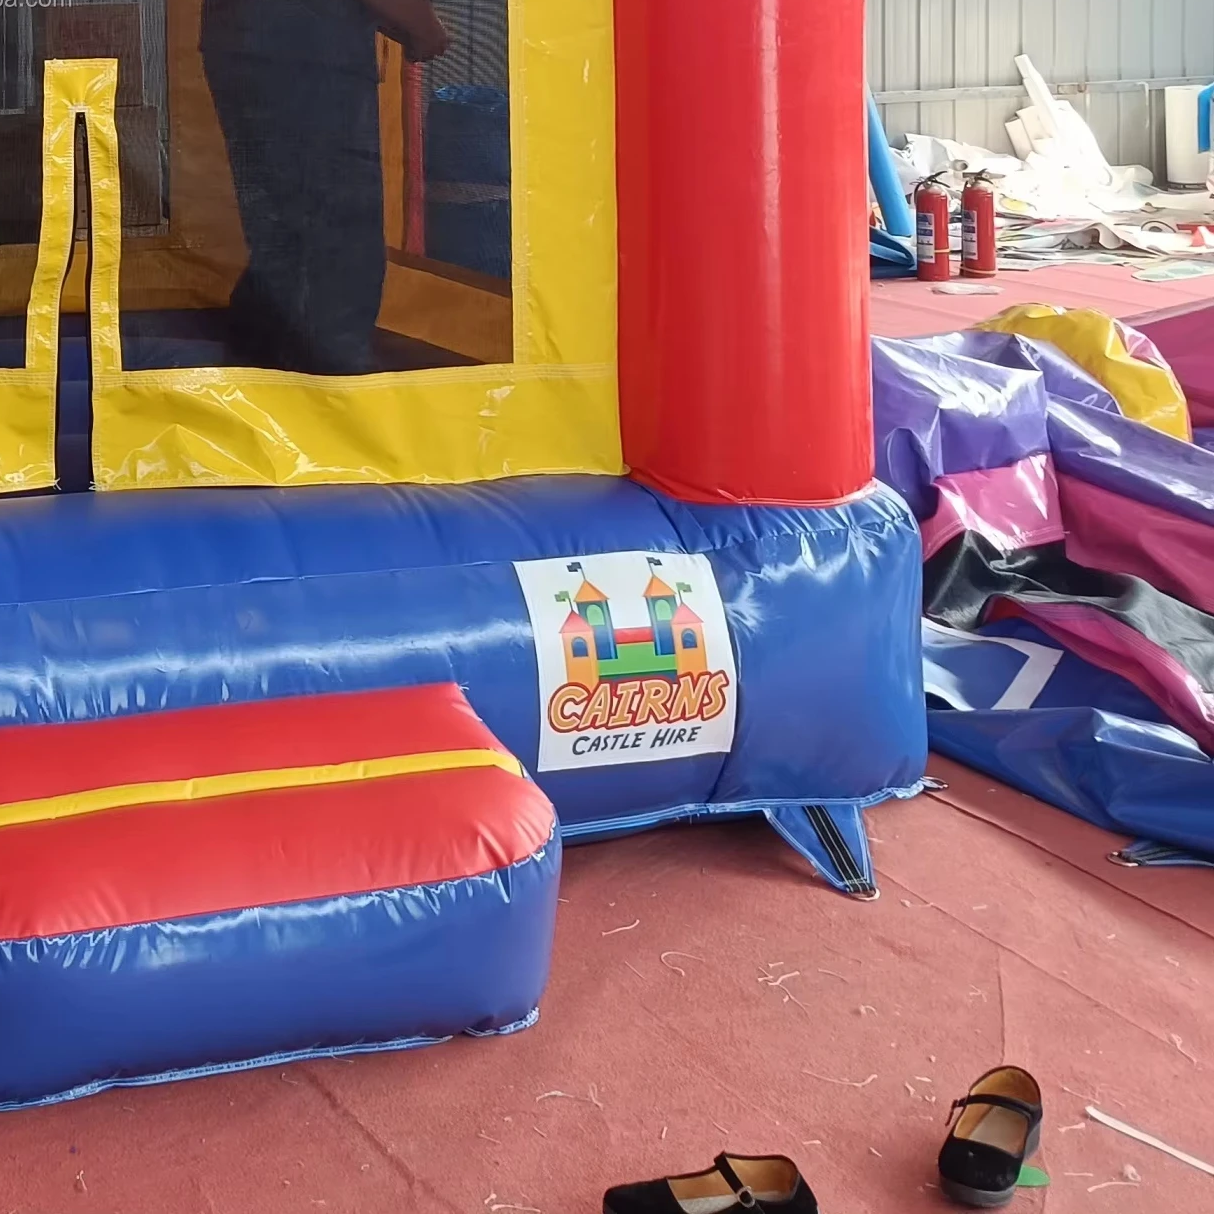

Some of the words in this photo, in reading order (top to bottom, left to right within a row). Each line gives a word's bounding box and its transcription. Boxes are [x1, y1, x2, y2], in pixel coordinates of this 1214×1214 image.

[549, 671, 729, 732] CAIRNS
[572, 733, 646, 755] CASTLE
[650, 726, 702, 748] HIRE
